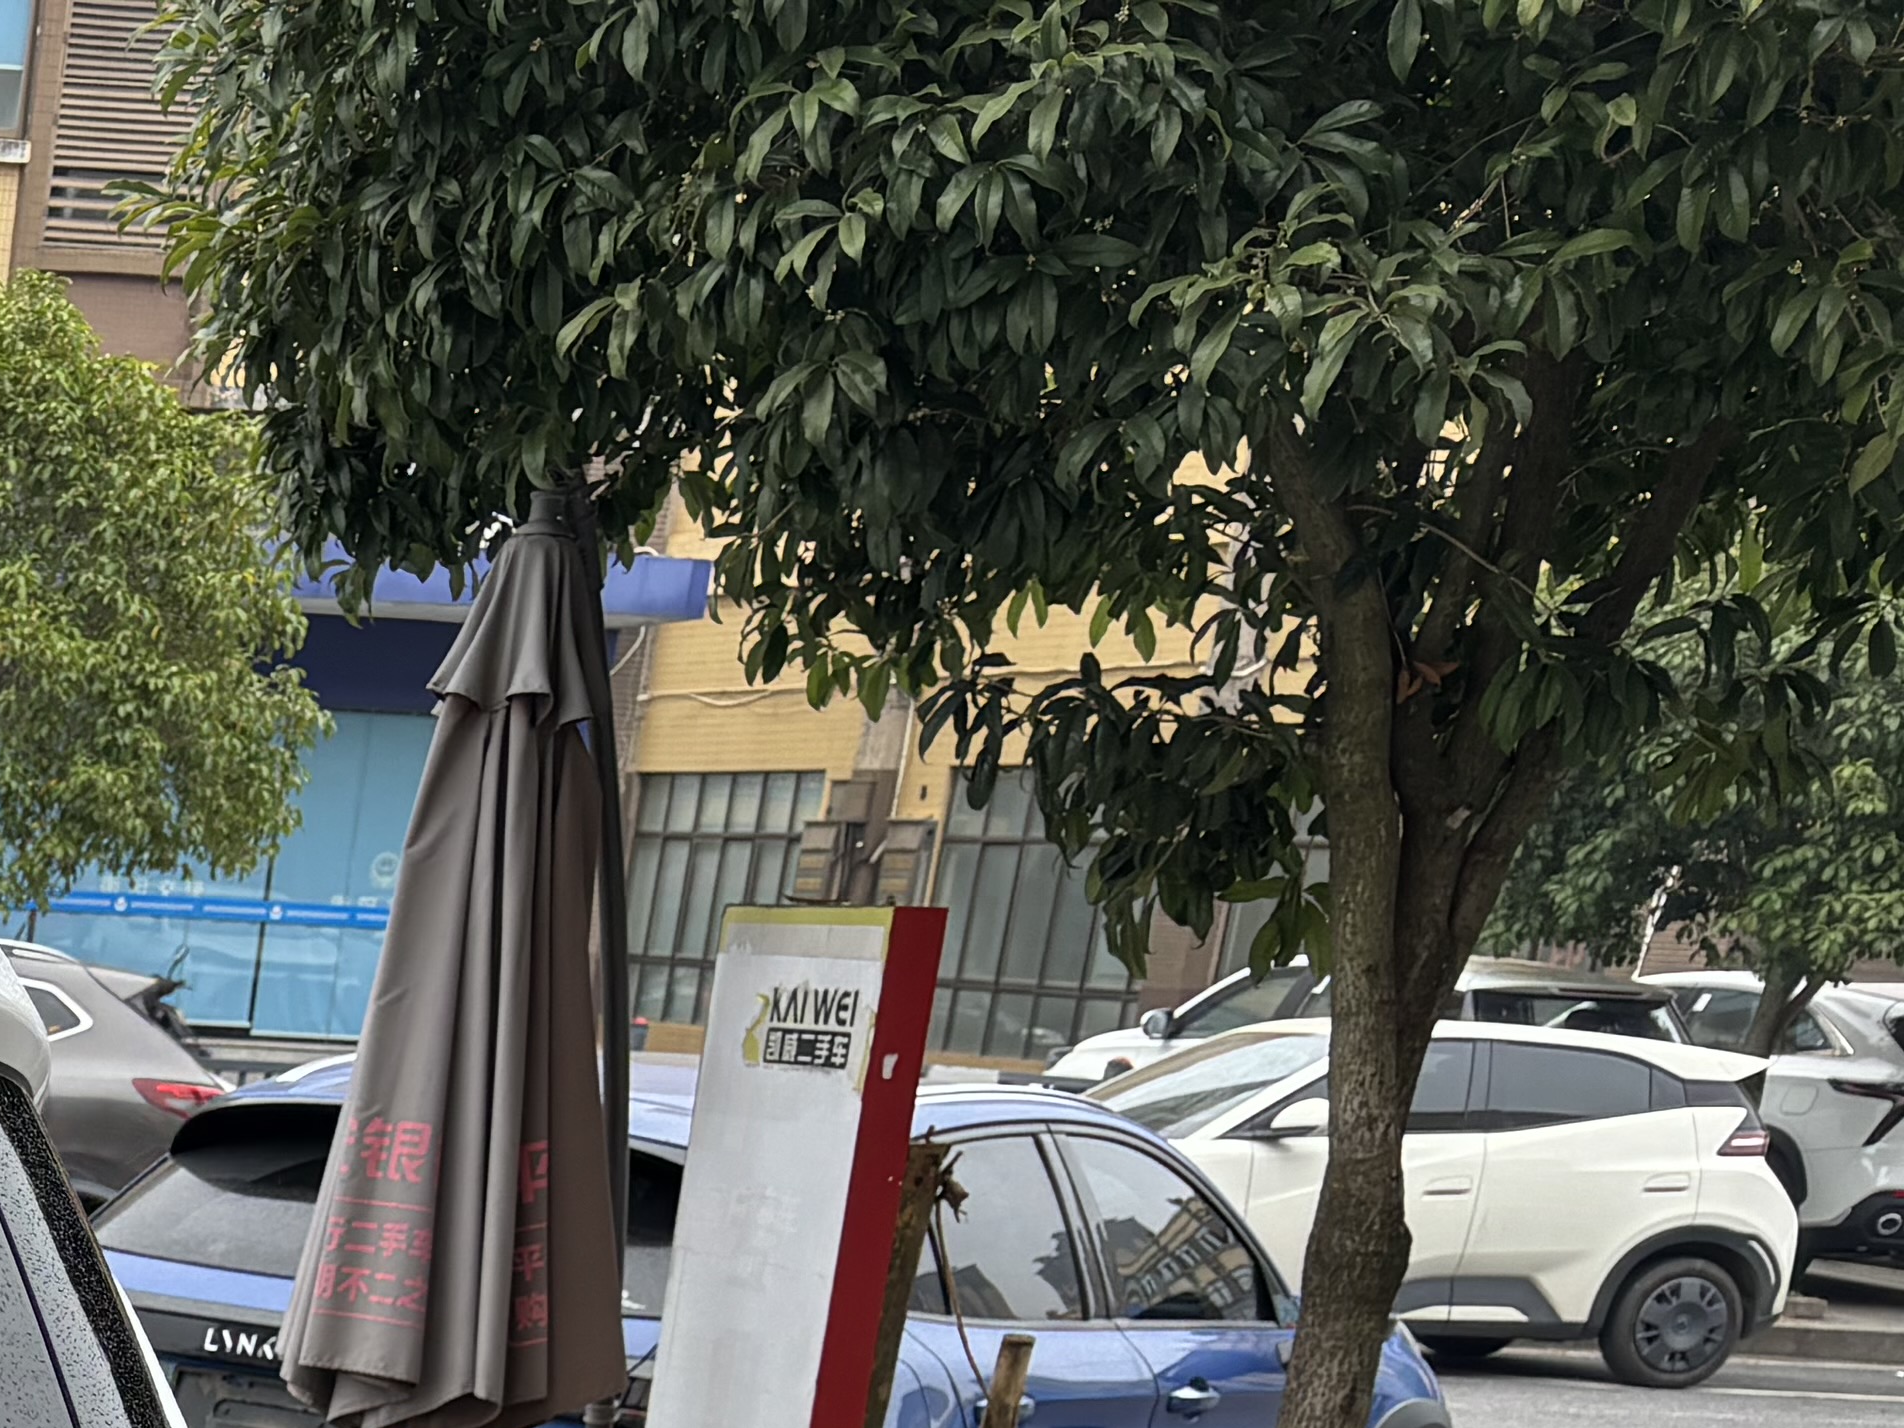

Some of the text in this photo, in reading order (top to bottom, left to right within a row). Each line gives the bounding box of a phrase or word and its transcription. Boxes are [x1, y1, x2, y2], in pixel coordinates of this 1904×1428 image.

[765, 1030, 849, 1066] 凯威二手车
